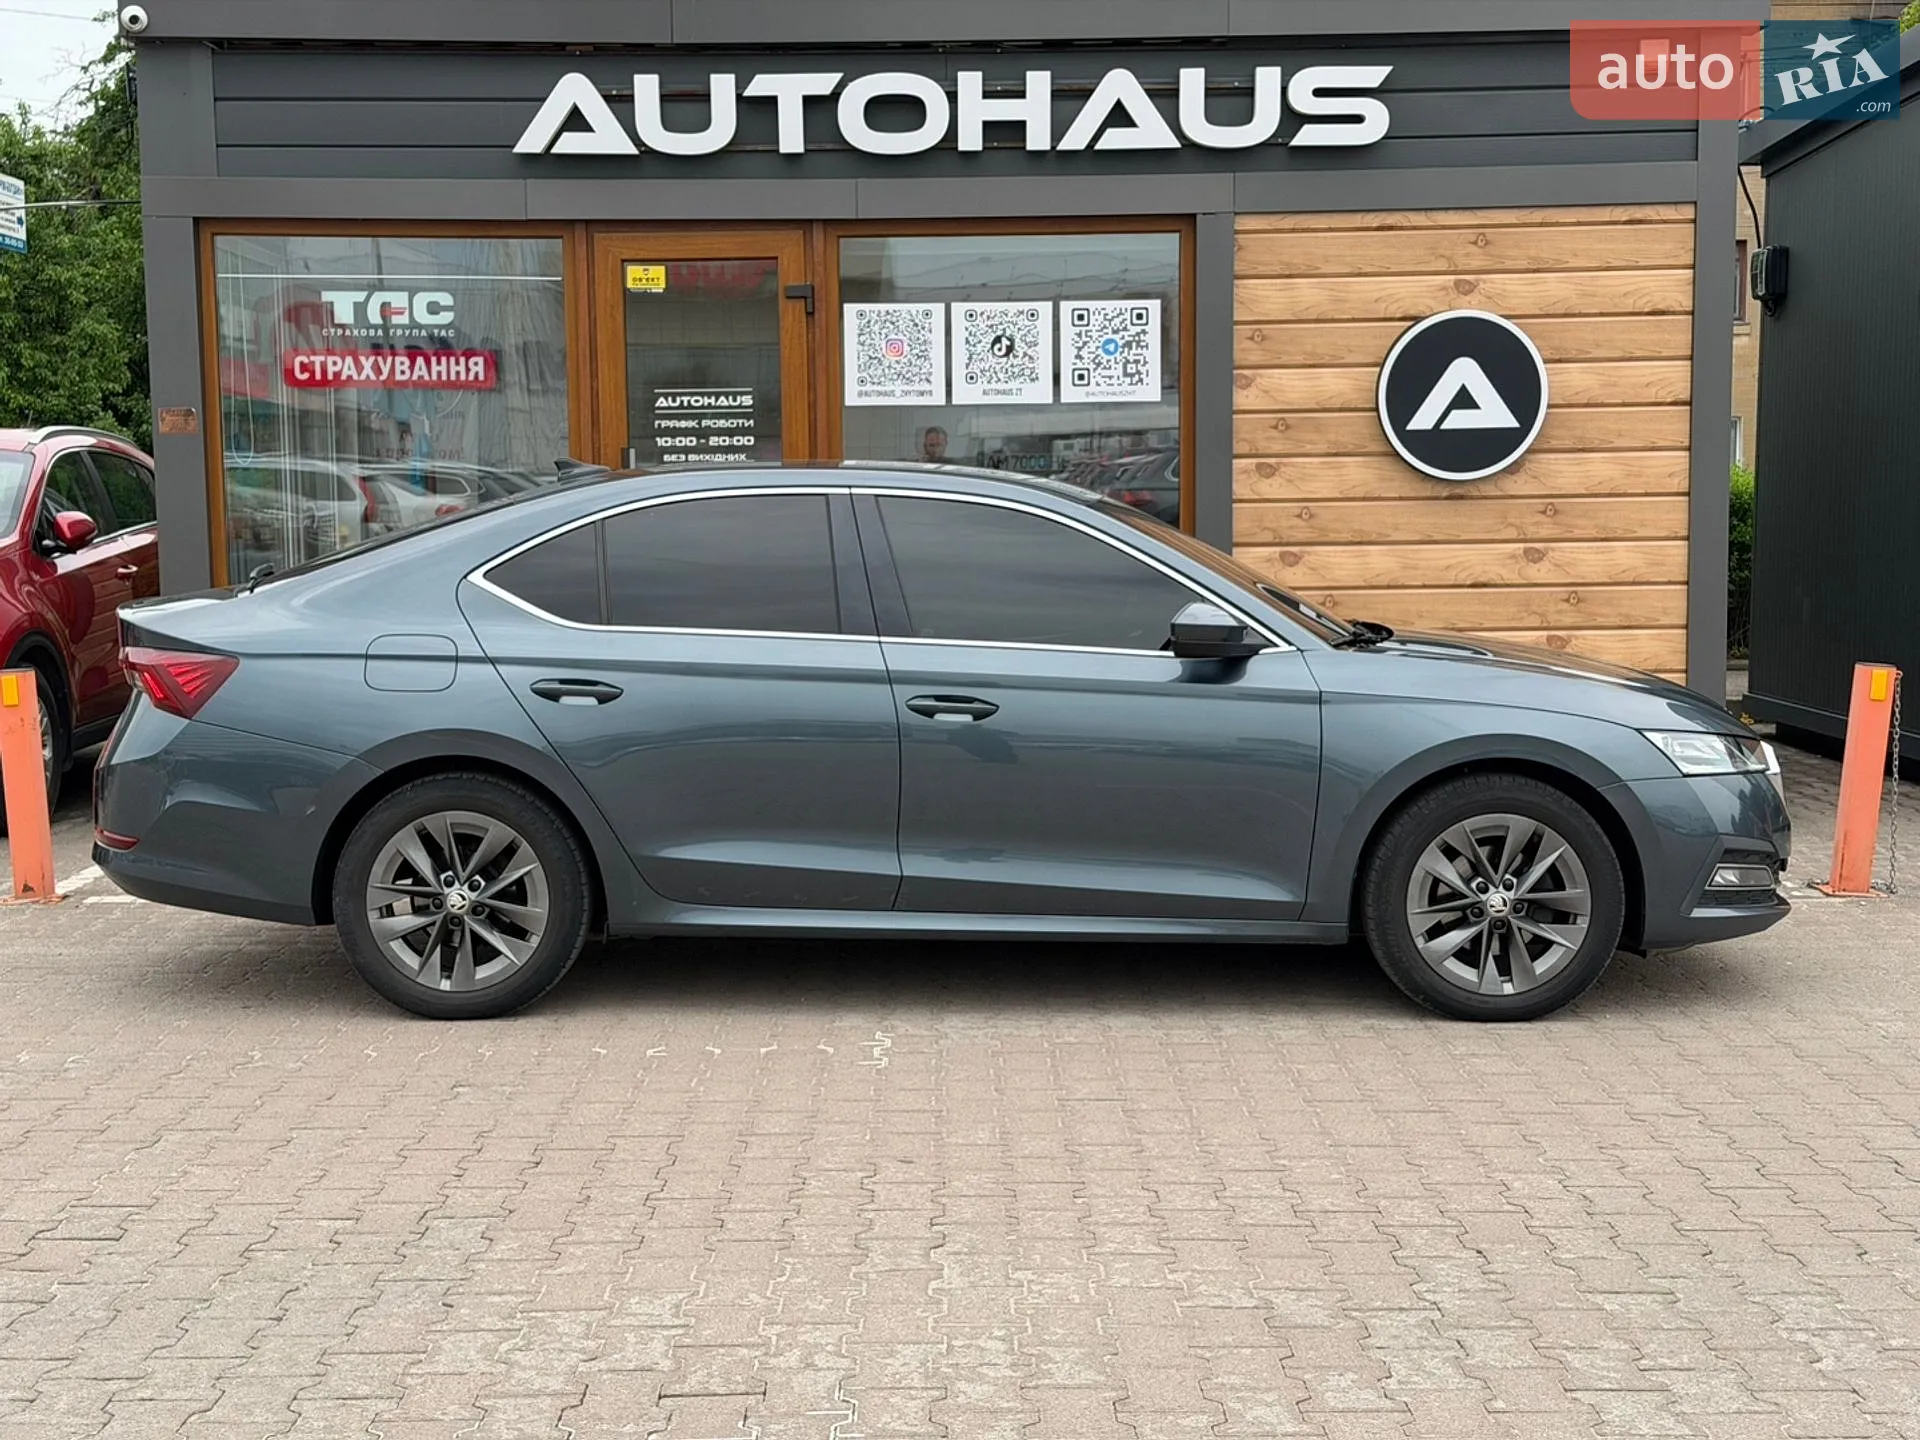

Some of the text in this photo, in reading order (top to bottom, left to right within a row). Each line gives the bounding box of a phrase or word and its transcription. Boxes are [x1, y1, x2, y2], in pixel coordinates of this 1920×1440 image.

[512, 66, 1395, 155] AUTOHAUS
[321, 328, 456, 338] СТРАХОВА ГРУПА ТАС
[293, 354, 486, 382] СТРАХУВАННЯ
[654, 395, 754, 408] AUTOHAUS
[654, 419, 754, 429] ГРАФІК РОБОТИ
[655, 436, 697, 447] 10:00
[708, 436, 755, 446] 20:00
[663, 452, 747, 462] БЕЗ ВИХІДНИХ
